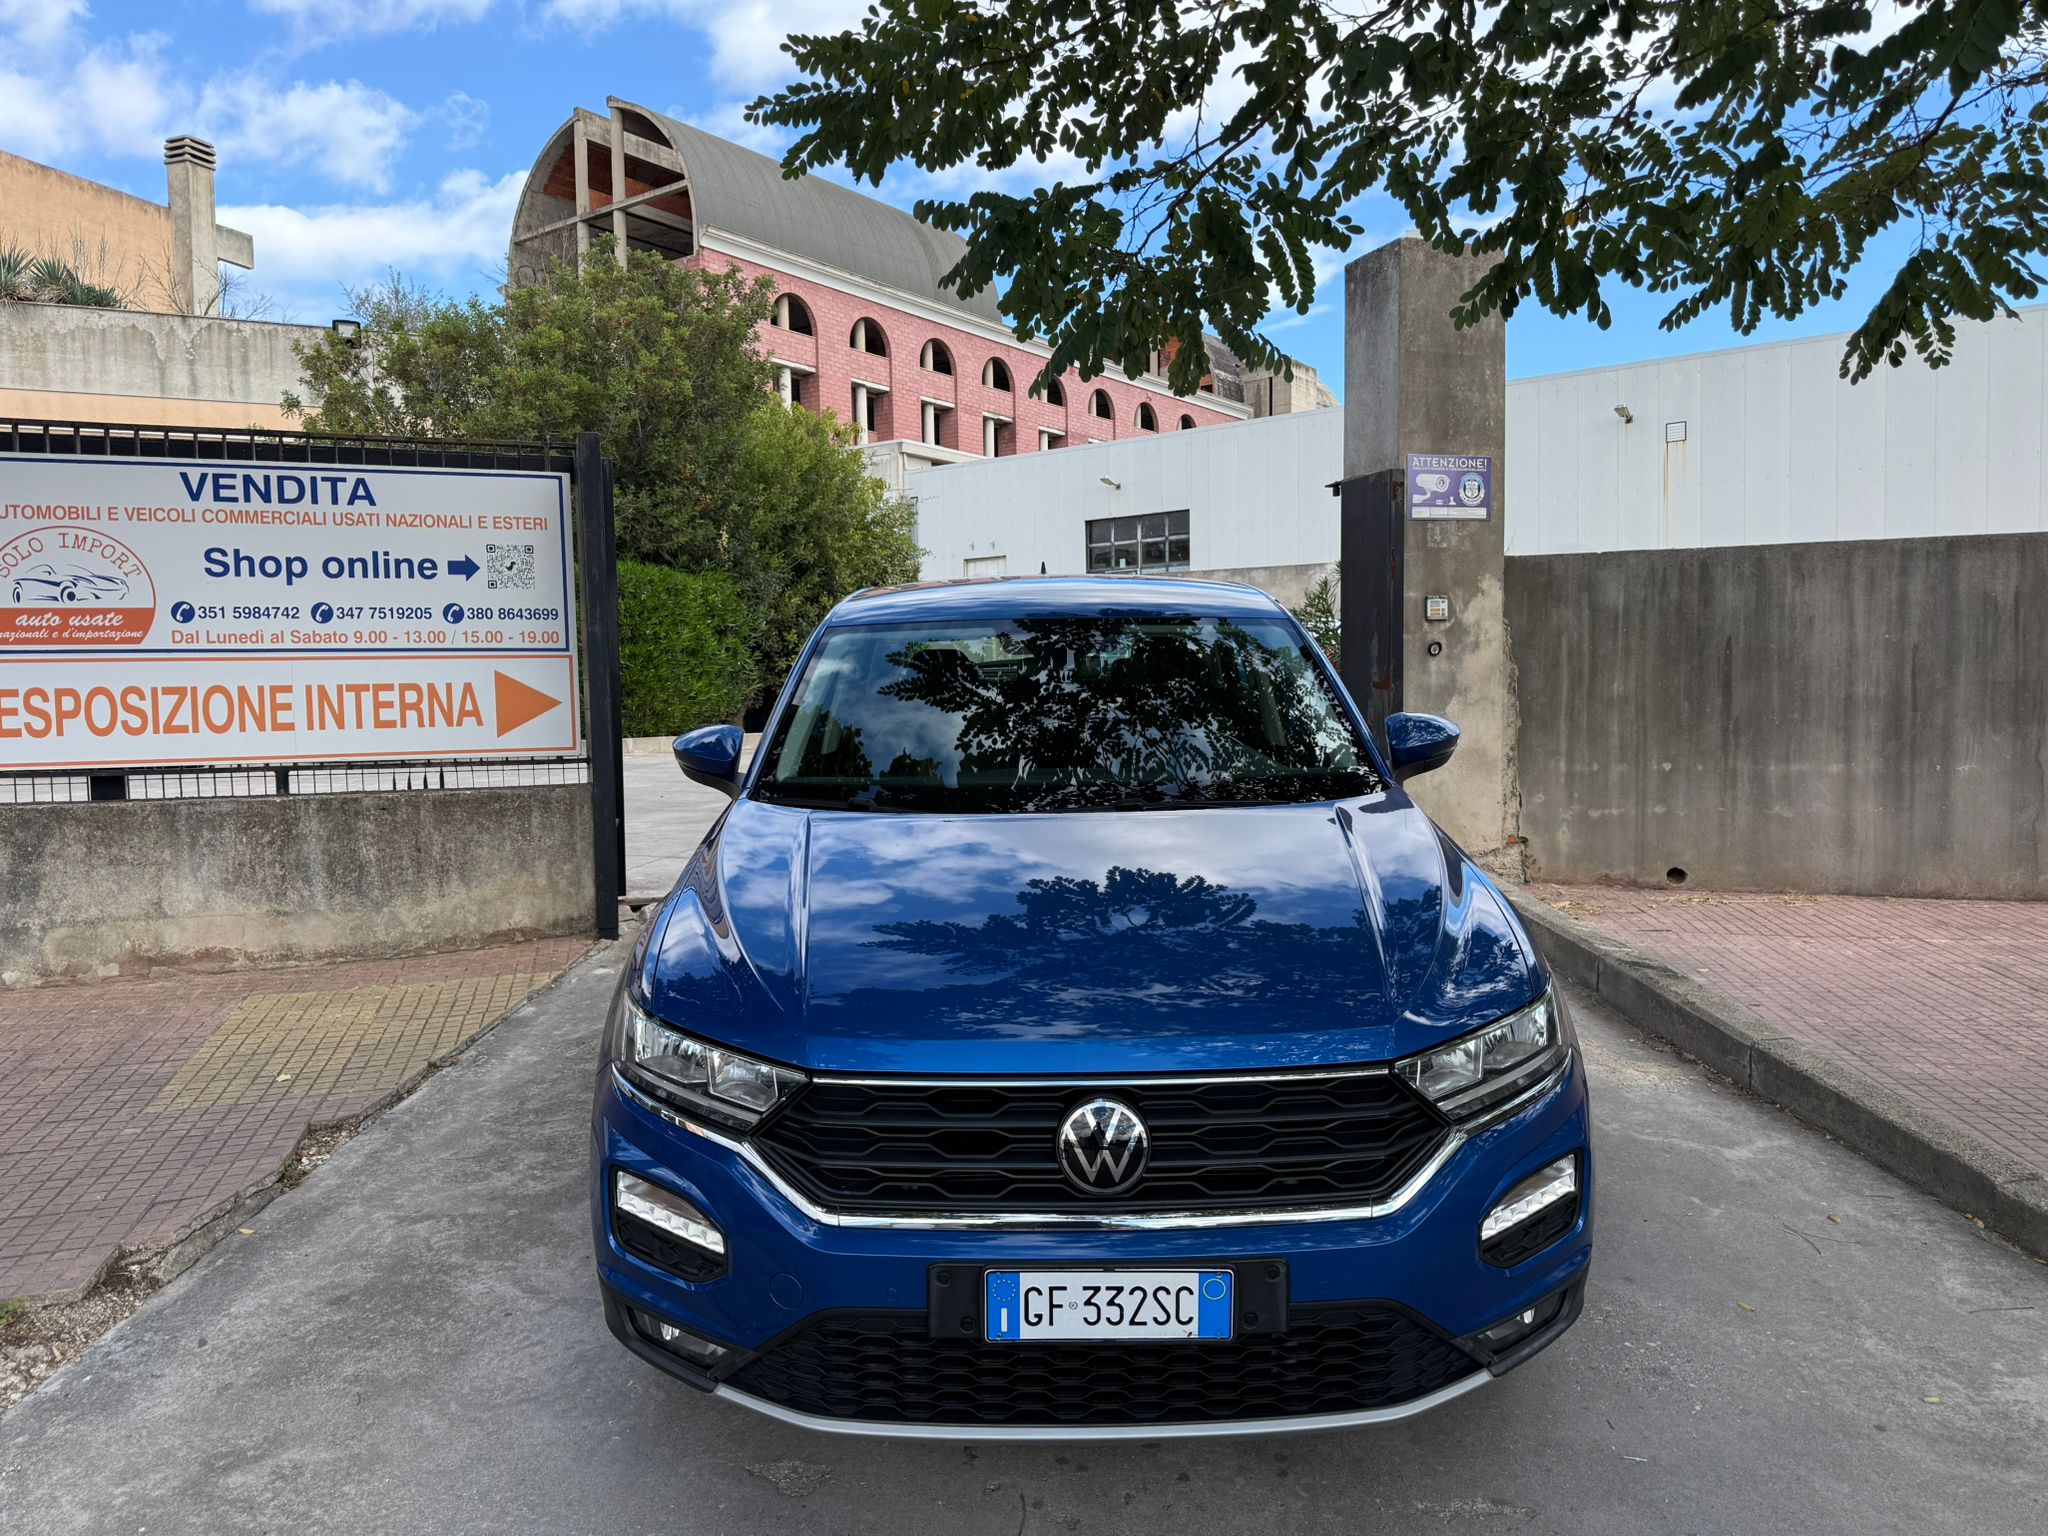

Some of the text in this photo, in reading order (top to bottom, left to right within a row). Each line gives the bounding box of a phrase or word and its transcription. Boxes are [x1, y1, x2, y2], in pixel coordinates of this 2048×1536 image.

[1412, 457, 1487, 469] ATTENZIONE!
[179, 472, 377, 506] VENDITA
[107, 506, 119, 521] E
[124, 506, 196, 523] VEICOLI
[201, 508, 327, 526] COMMERCIALI
[332, 512, 380, 528] USATI
[386, 513, 472, 530] NAZIONALI
[478, 515, 488, 530] E
[493, 516, 548, 531] ESTERI
[58, 532, 142, 578] IMPORT
[204, 547, 438, 586] Shop online
[15, 612, 124, 627] auto usate
[198, 606, 300, 620] 351 5984742
[336, 607, 432, 620] 347 7519205
[467, 607, 559, 620] 380 8643699
[52, 630, 59, 638] e
[62, 627, 144, 641] d'importazione
[171, 630, 199, 644] Dal
[206, 629, 264, 644] Lunedì
[270, 630, 284, 644] al
[290, 630, 348, 644] Sabato
[353, 630, 387, 643] 9.00
[404, 630, 446, 644] 13.00
[451, 630, 456, 645] /
[462, 631, 503, 644] 15.00
[519, 631, 560, 644] 19.00
[0, 681, 484, 739] ESPOSIZIONE INTERNA
[1060, 1101, 1148, 1191] VW
[1024, 1286, 1194, 1327] GF 332SC
